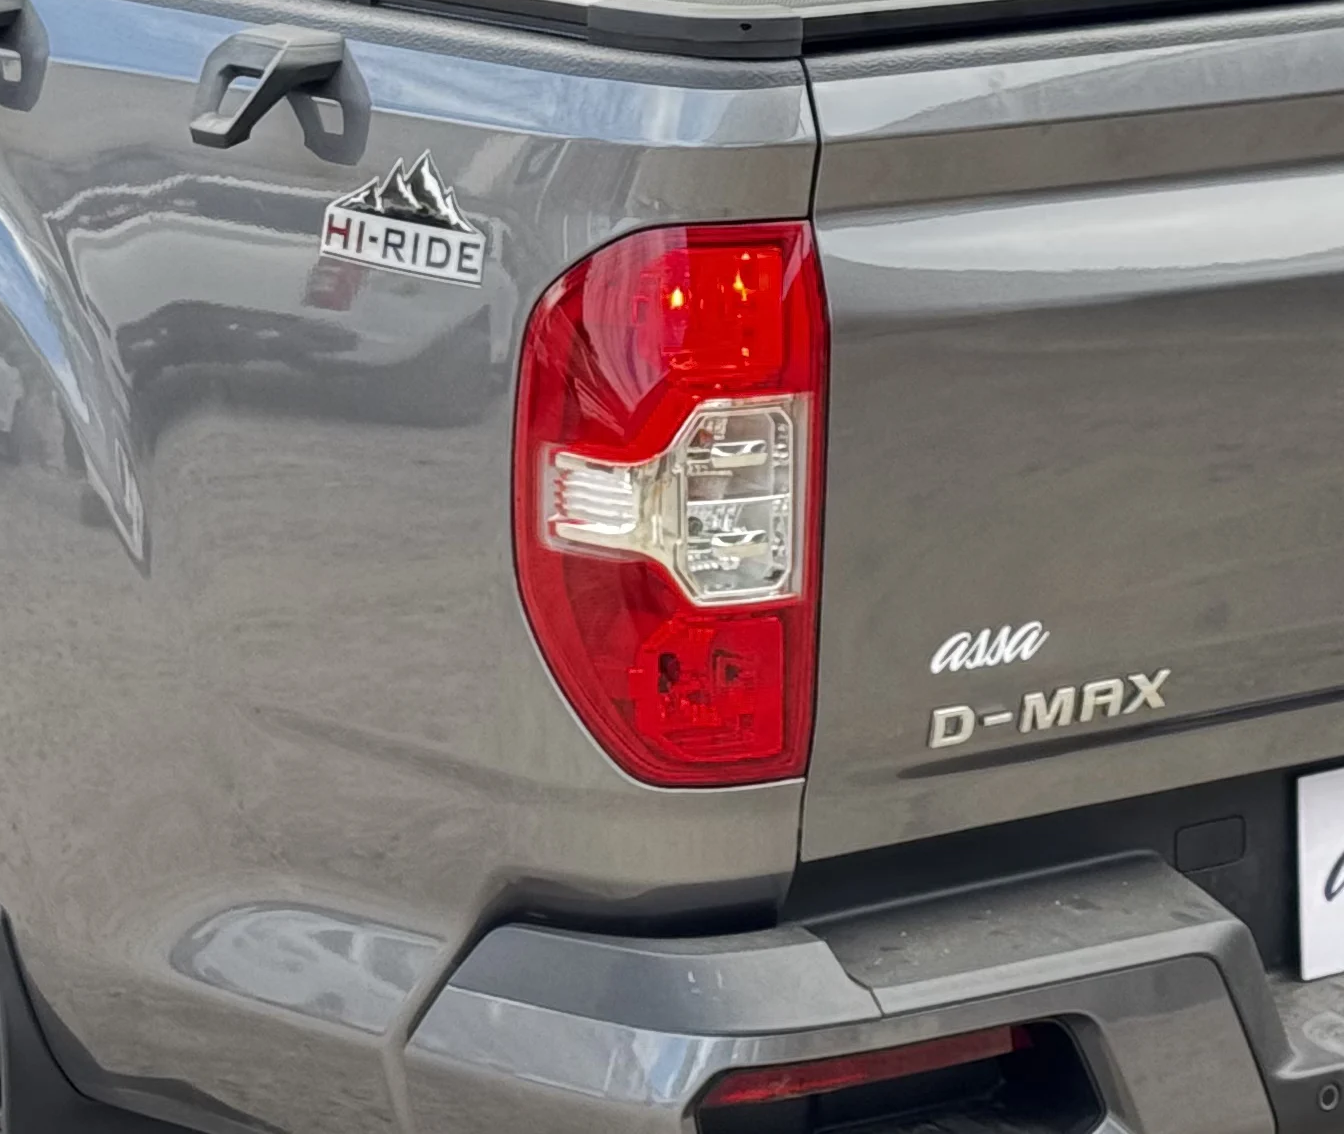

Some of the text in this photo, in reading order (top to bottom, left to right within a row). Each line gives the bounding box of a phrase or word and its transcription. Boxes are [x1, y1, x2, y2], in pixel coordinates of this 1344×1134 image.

[325, 213, 481, 275] HI-RIDE
[930, 621, 1051, 674] assa
[928, 669, 1171, 749] D-MAX
